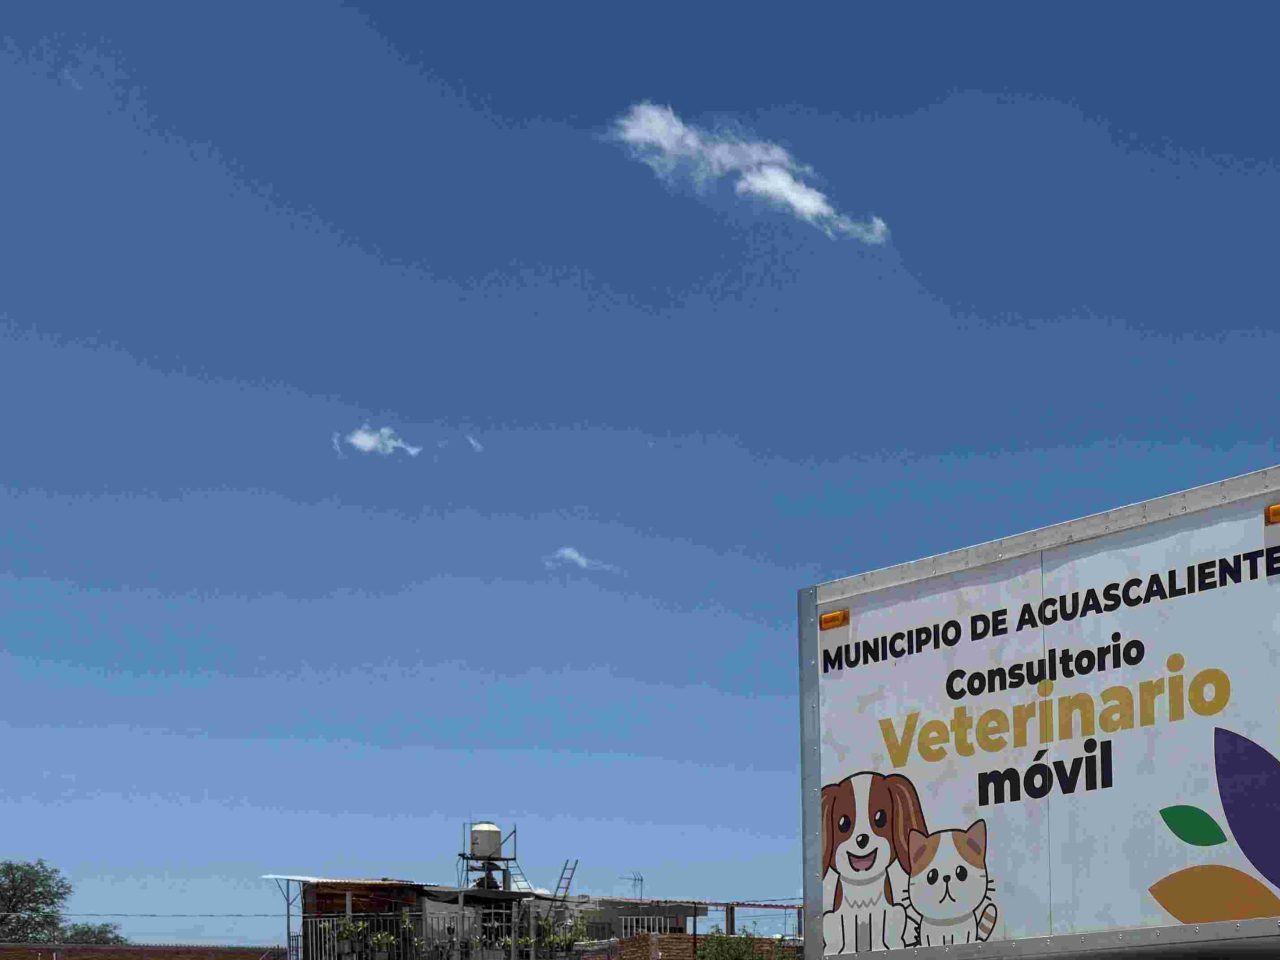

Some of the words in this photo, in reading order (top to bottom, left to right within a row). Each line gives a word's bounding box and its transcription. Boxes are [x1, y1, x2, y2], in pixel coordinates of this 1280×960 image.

[822, 619, 962, 673] MUNICIPIO
[971, 609, 1008, 641] DE
[946, 632, 1145, 700] Consultorio
[879, 653, 1231, 768] Veterinario
[977, 738, 1114, 806] móvil
